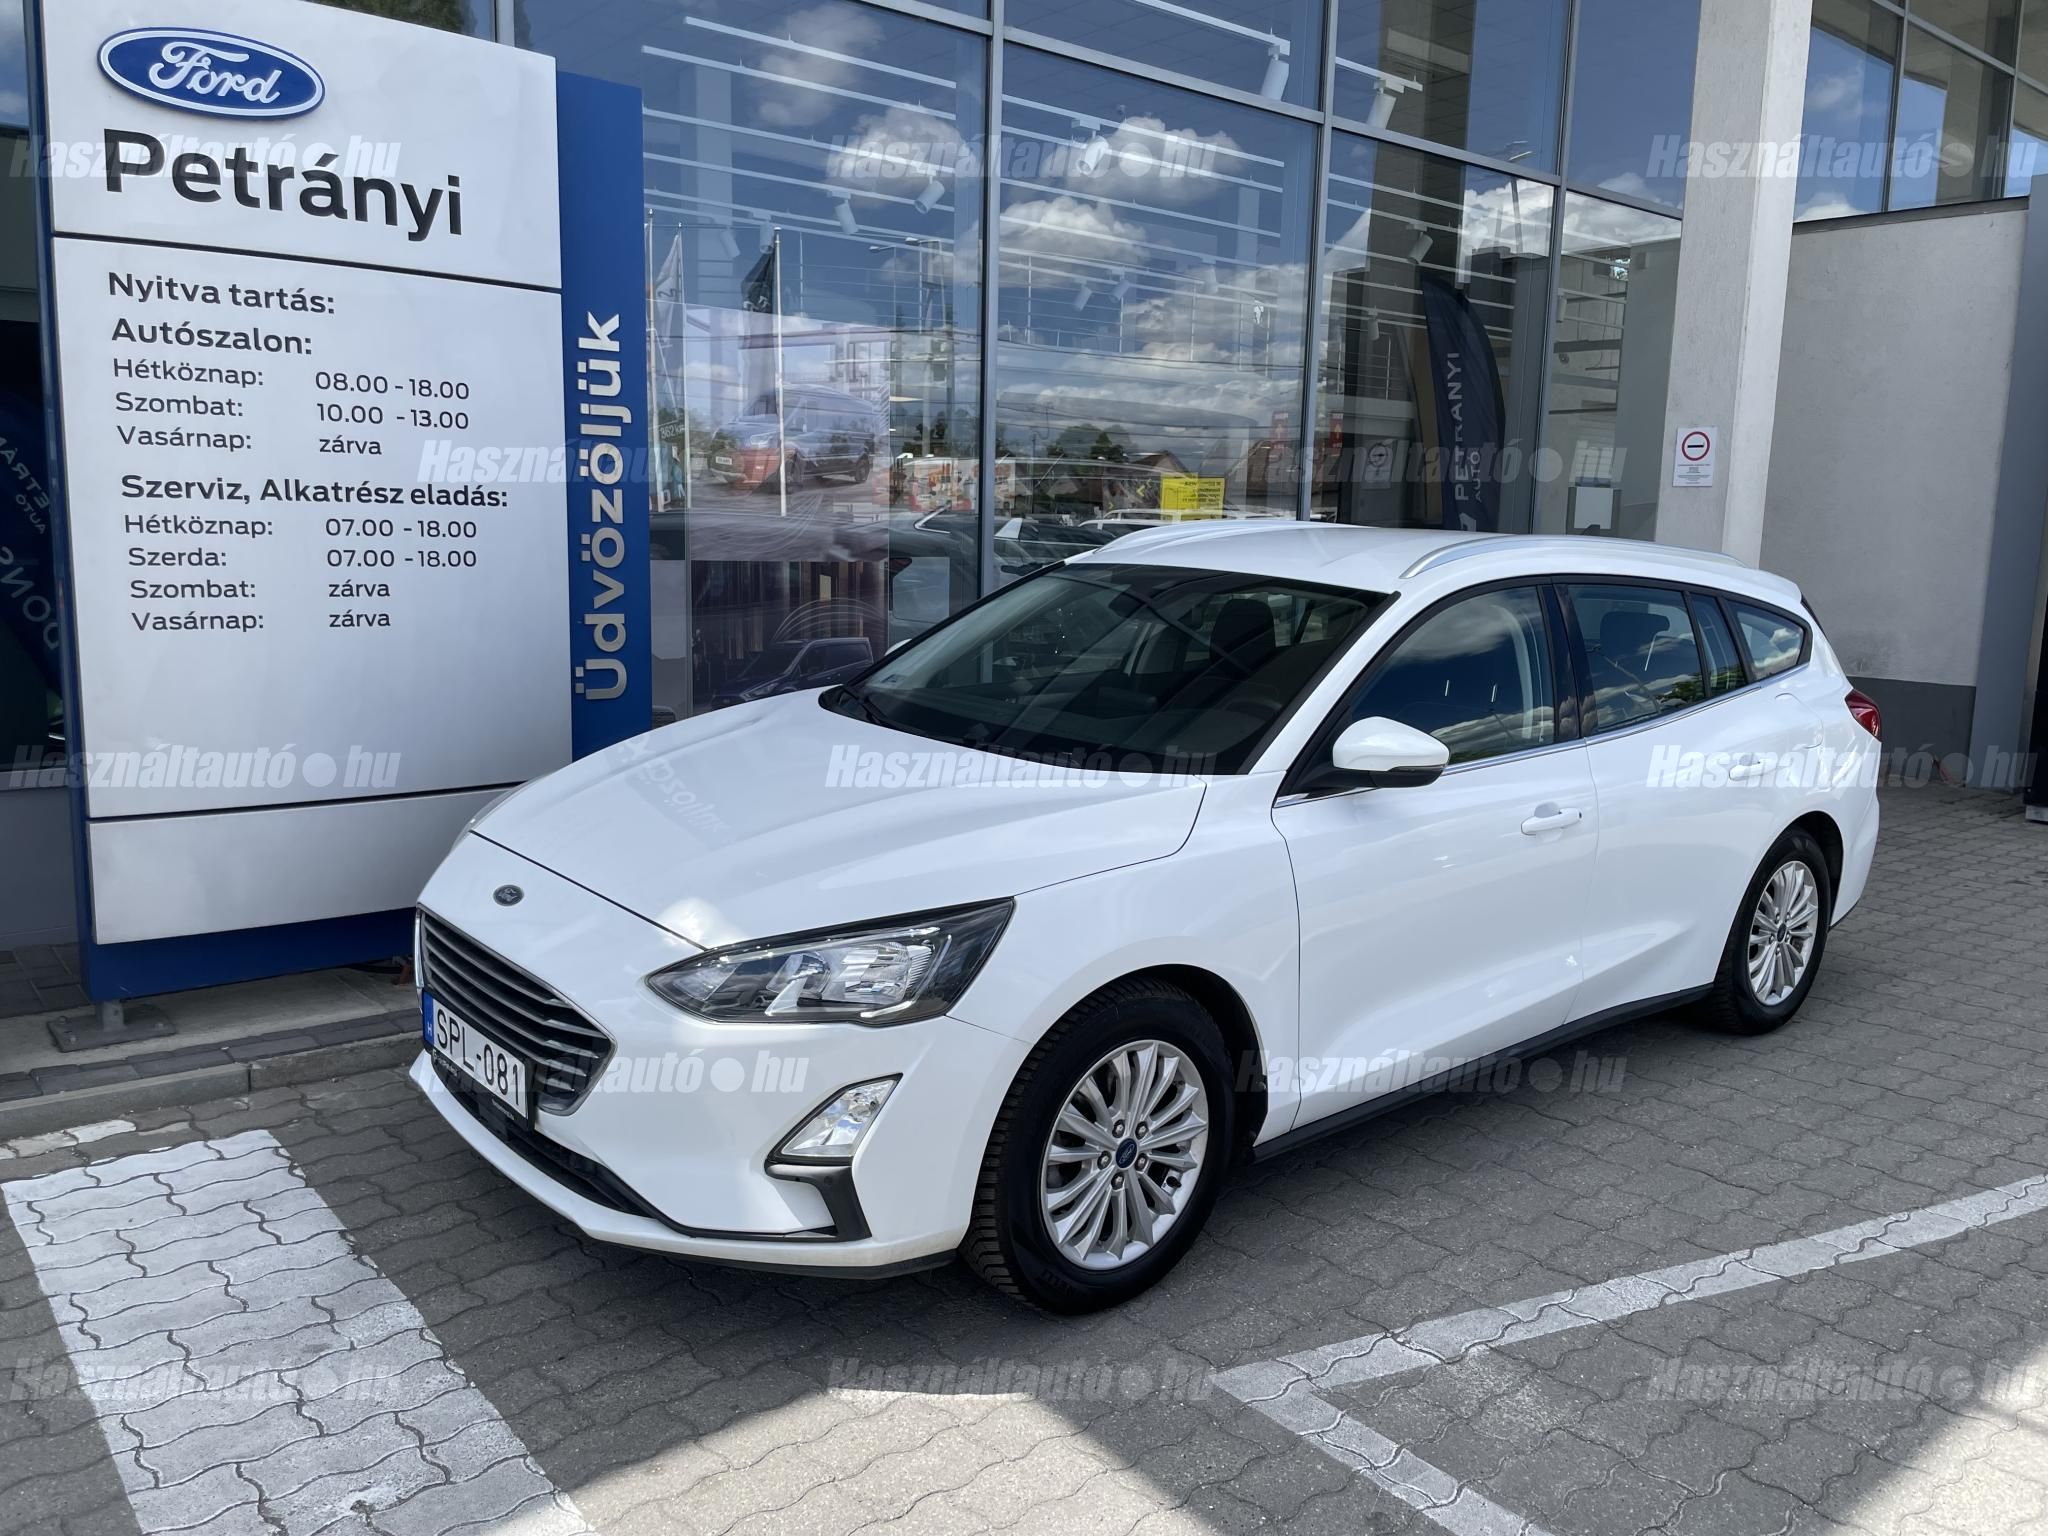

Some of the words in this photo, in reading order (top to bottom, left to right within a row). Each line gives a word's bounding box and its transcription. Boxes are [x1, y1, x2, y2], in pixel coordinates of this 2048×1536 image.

[148, 41, 284, 104] Ford
[104, 128, 461, 242] Petrányi
[109, 272, 221, 304] Nyitva
[229, 284, 334, 314] tartás:
[112, 318, 312, 355] Autószalon:
[114, 358, 263, 387] Hétköznap:
[315, 372, 388, 394] 08.00
[409, 378, 469, 400] 18.00
[116, 391, 243, 416] Szombat:
[317, 403, 383, 424] 10.00
[411, 409, 469, 429] 13.00
[117, 425, 252, 453] Vasárnap:
[319, 434, 382, 455] zárva
[121, 475, 250, 504] Szerviz,
[261, 479, 404, 505] Alkatrész
[411, 484, 508, 508] eladás:
[575, 311, 631, 700] Üdvözöljük
[125, 515, 273, 539] Hétköznap:
[325, 518, 394, 537] 07.00
[418, 520, 477, 538] 18.00
[128, 547, 227, 567] Szerda:
[327, 549, 395, 567] 07.00
[418, 550, 477, 567] 18.00
[130, 579, 256, 599] Szombat:
[328, 579, 391, 598] zárva
[132, 610, 264, 633] Vasárnap:
[329, 609, 391, 628] zárva
[437, 1008, 519, 1106] SPL-081
